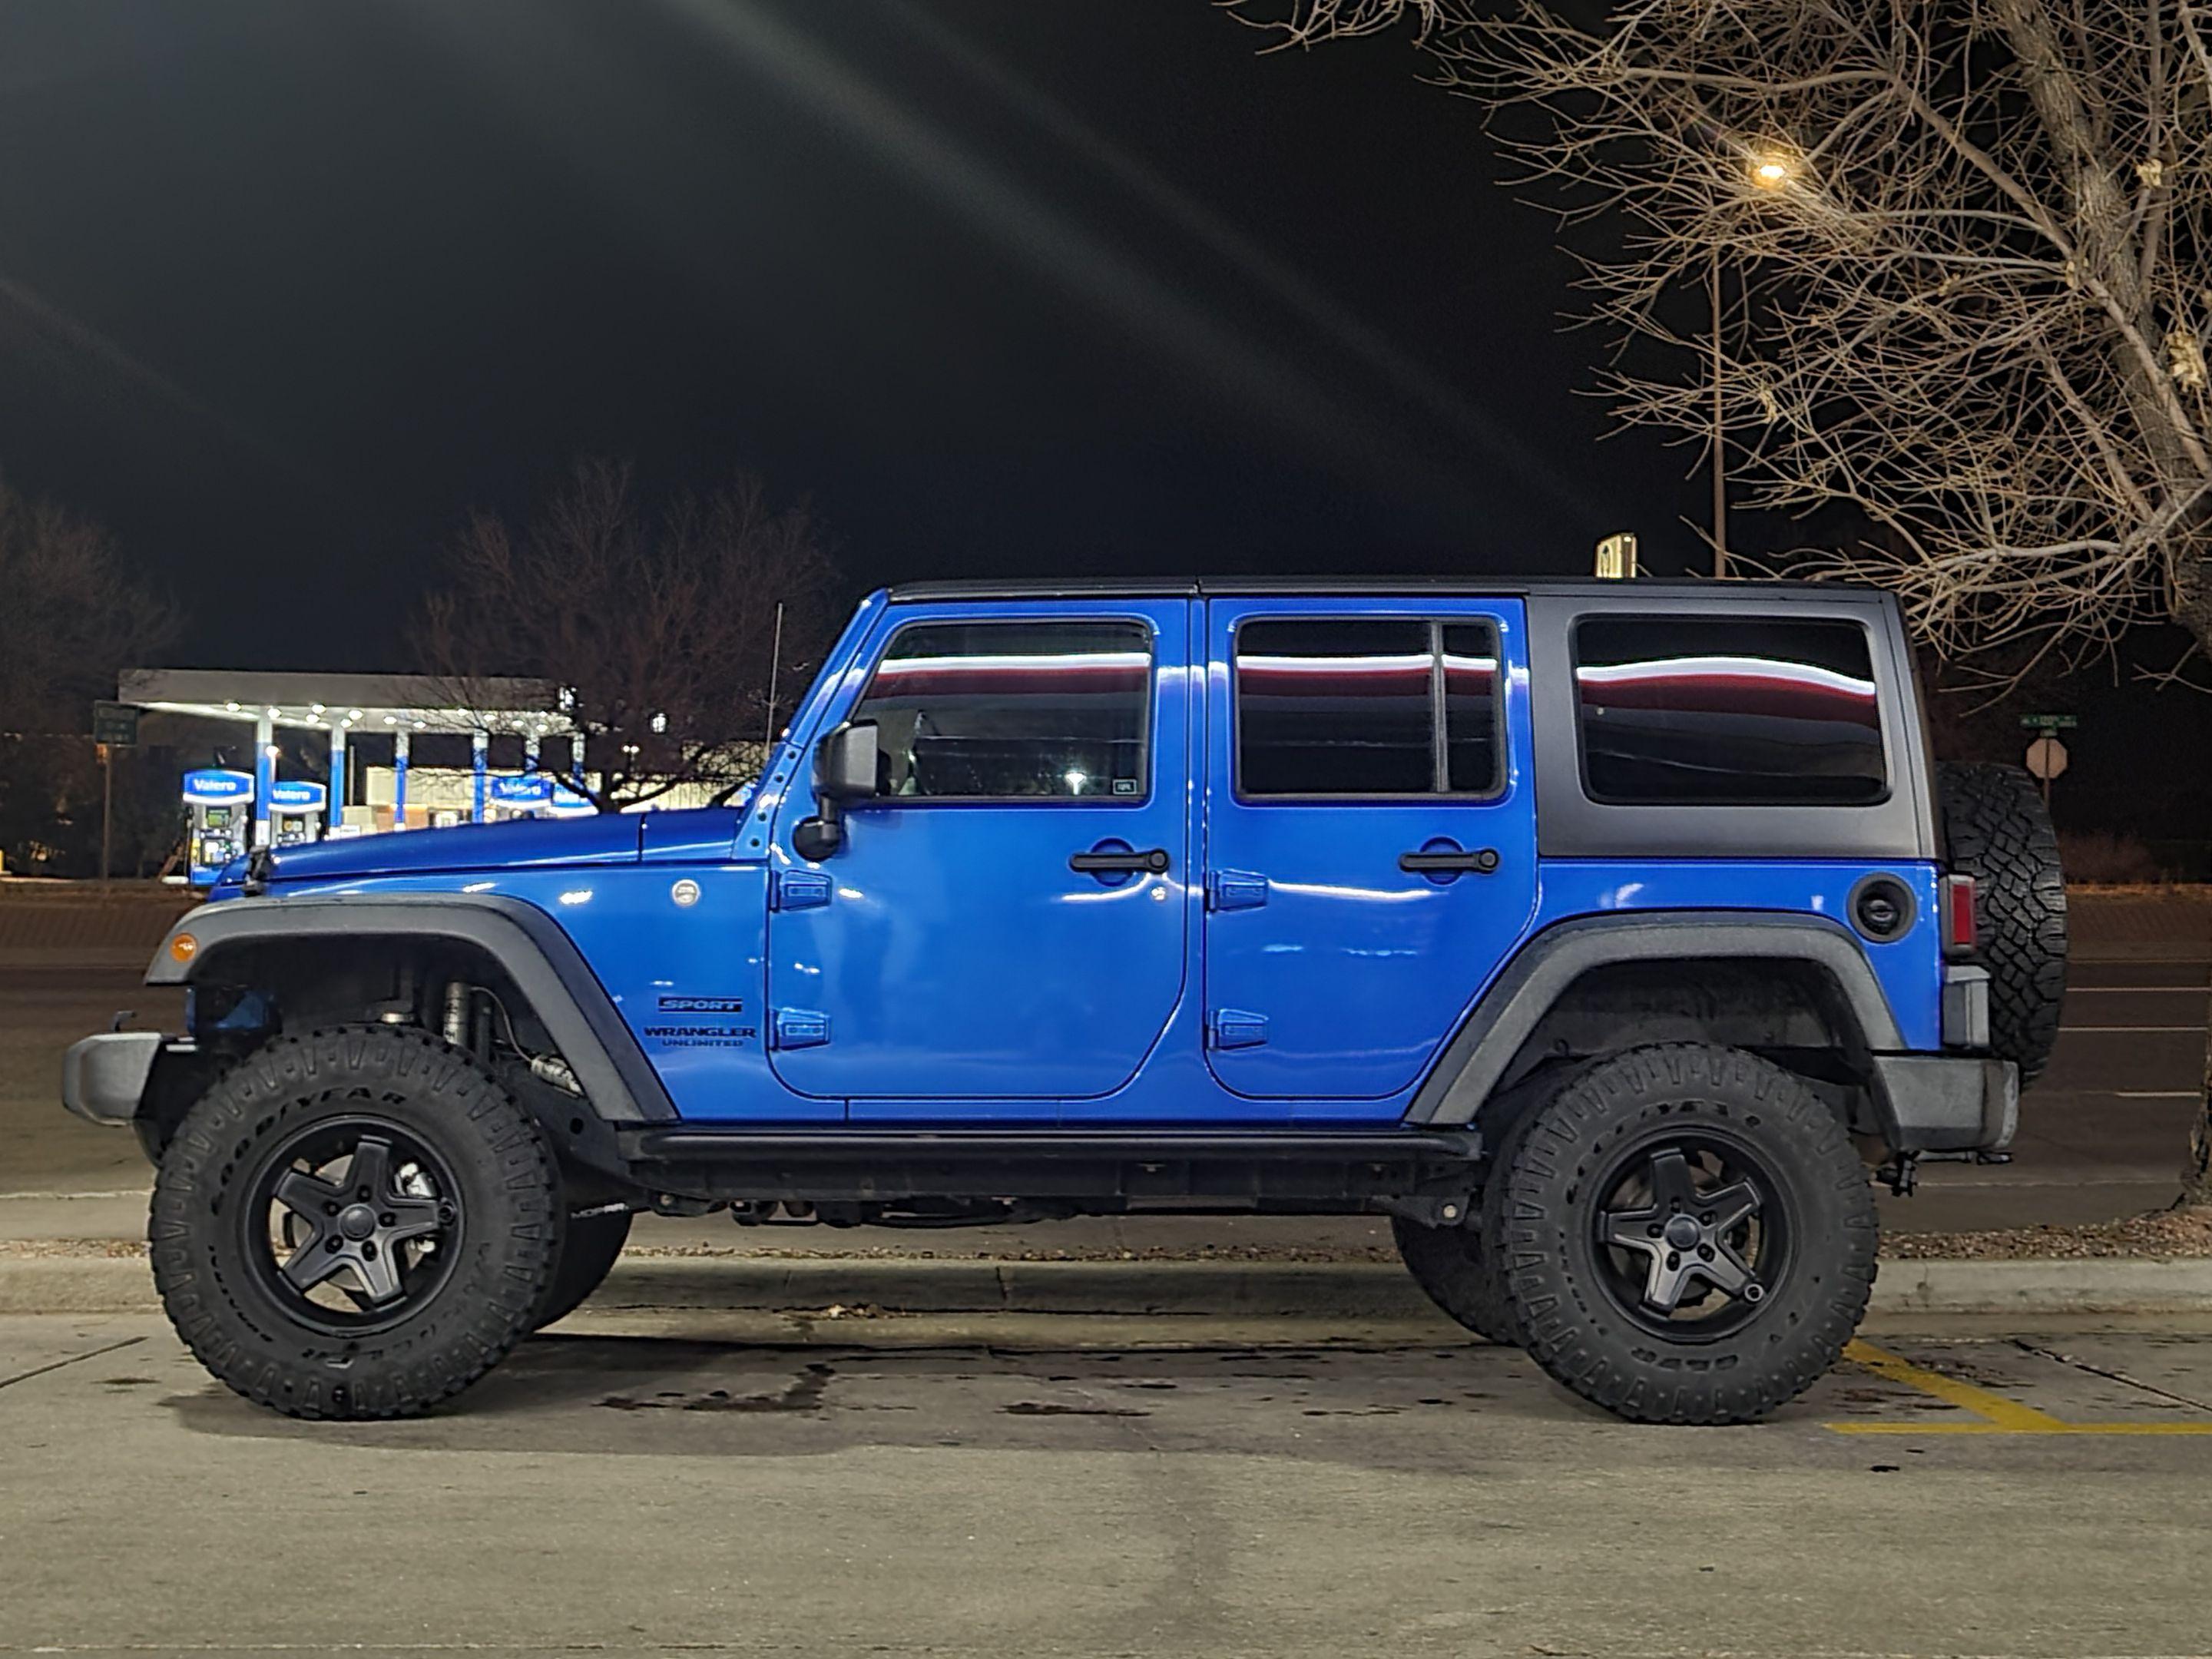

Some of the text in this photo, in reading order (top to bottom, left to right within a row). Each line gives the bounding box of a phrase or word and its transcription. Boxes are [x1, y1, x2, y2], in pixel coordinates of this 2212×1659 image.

[194, 778, 237, 791] Valero
[273, 790, 310, 801] Valero
[660, 999, 743, 1010] SPORT
[644, 1027, 757, 1038] WRANGLER
